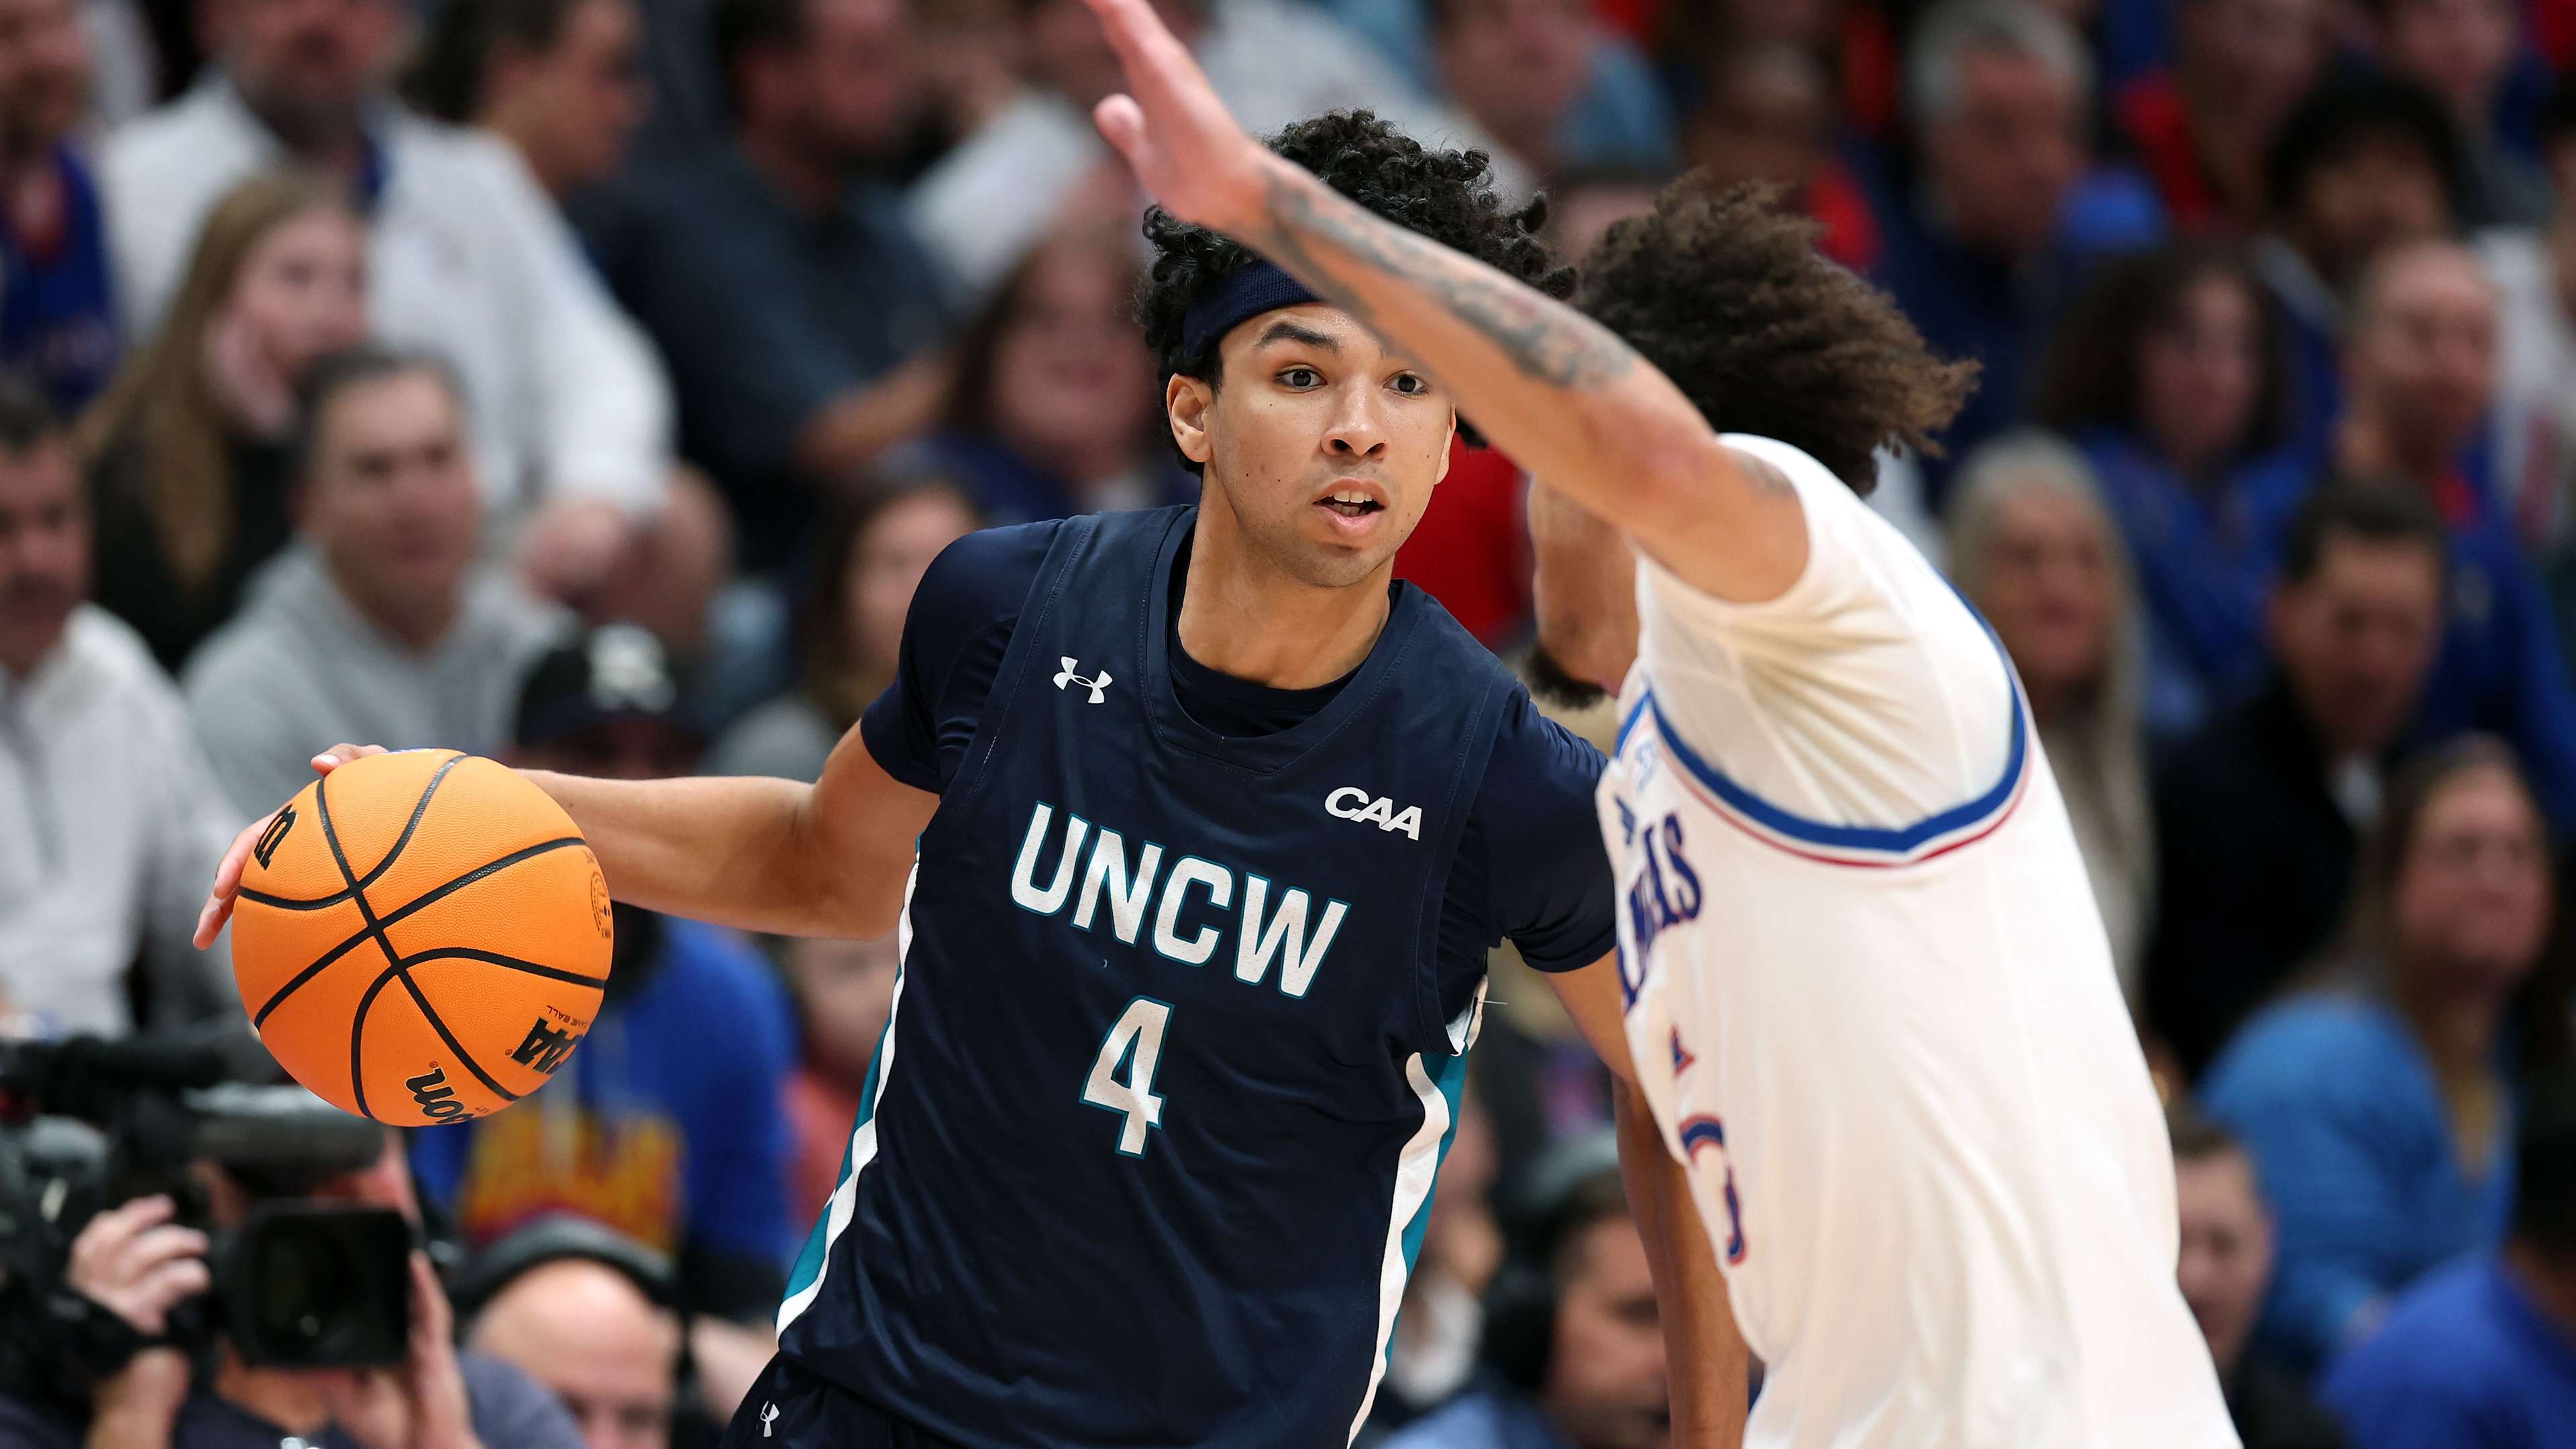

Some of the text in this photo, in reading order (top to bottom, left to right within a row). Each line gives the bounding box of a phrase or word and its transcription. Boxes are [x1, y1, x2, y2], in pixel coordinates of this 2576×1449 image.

[1324, 786, 1423, 841] CAA
[1010, 800, 1352, 1000] UNCW
[546, 1004, 571, 1023] BALL
[511, 1016, 584, 1075] AA
[1078, 994, 1176, 1159] 4
